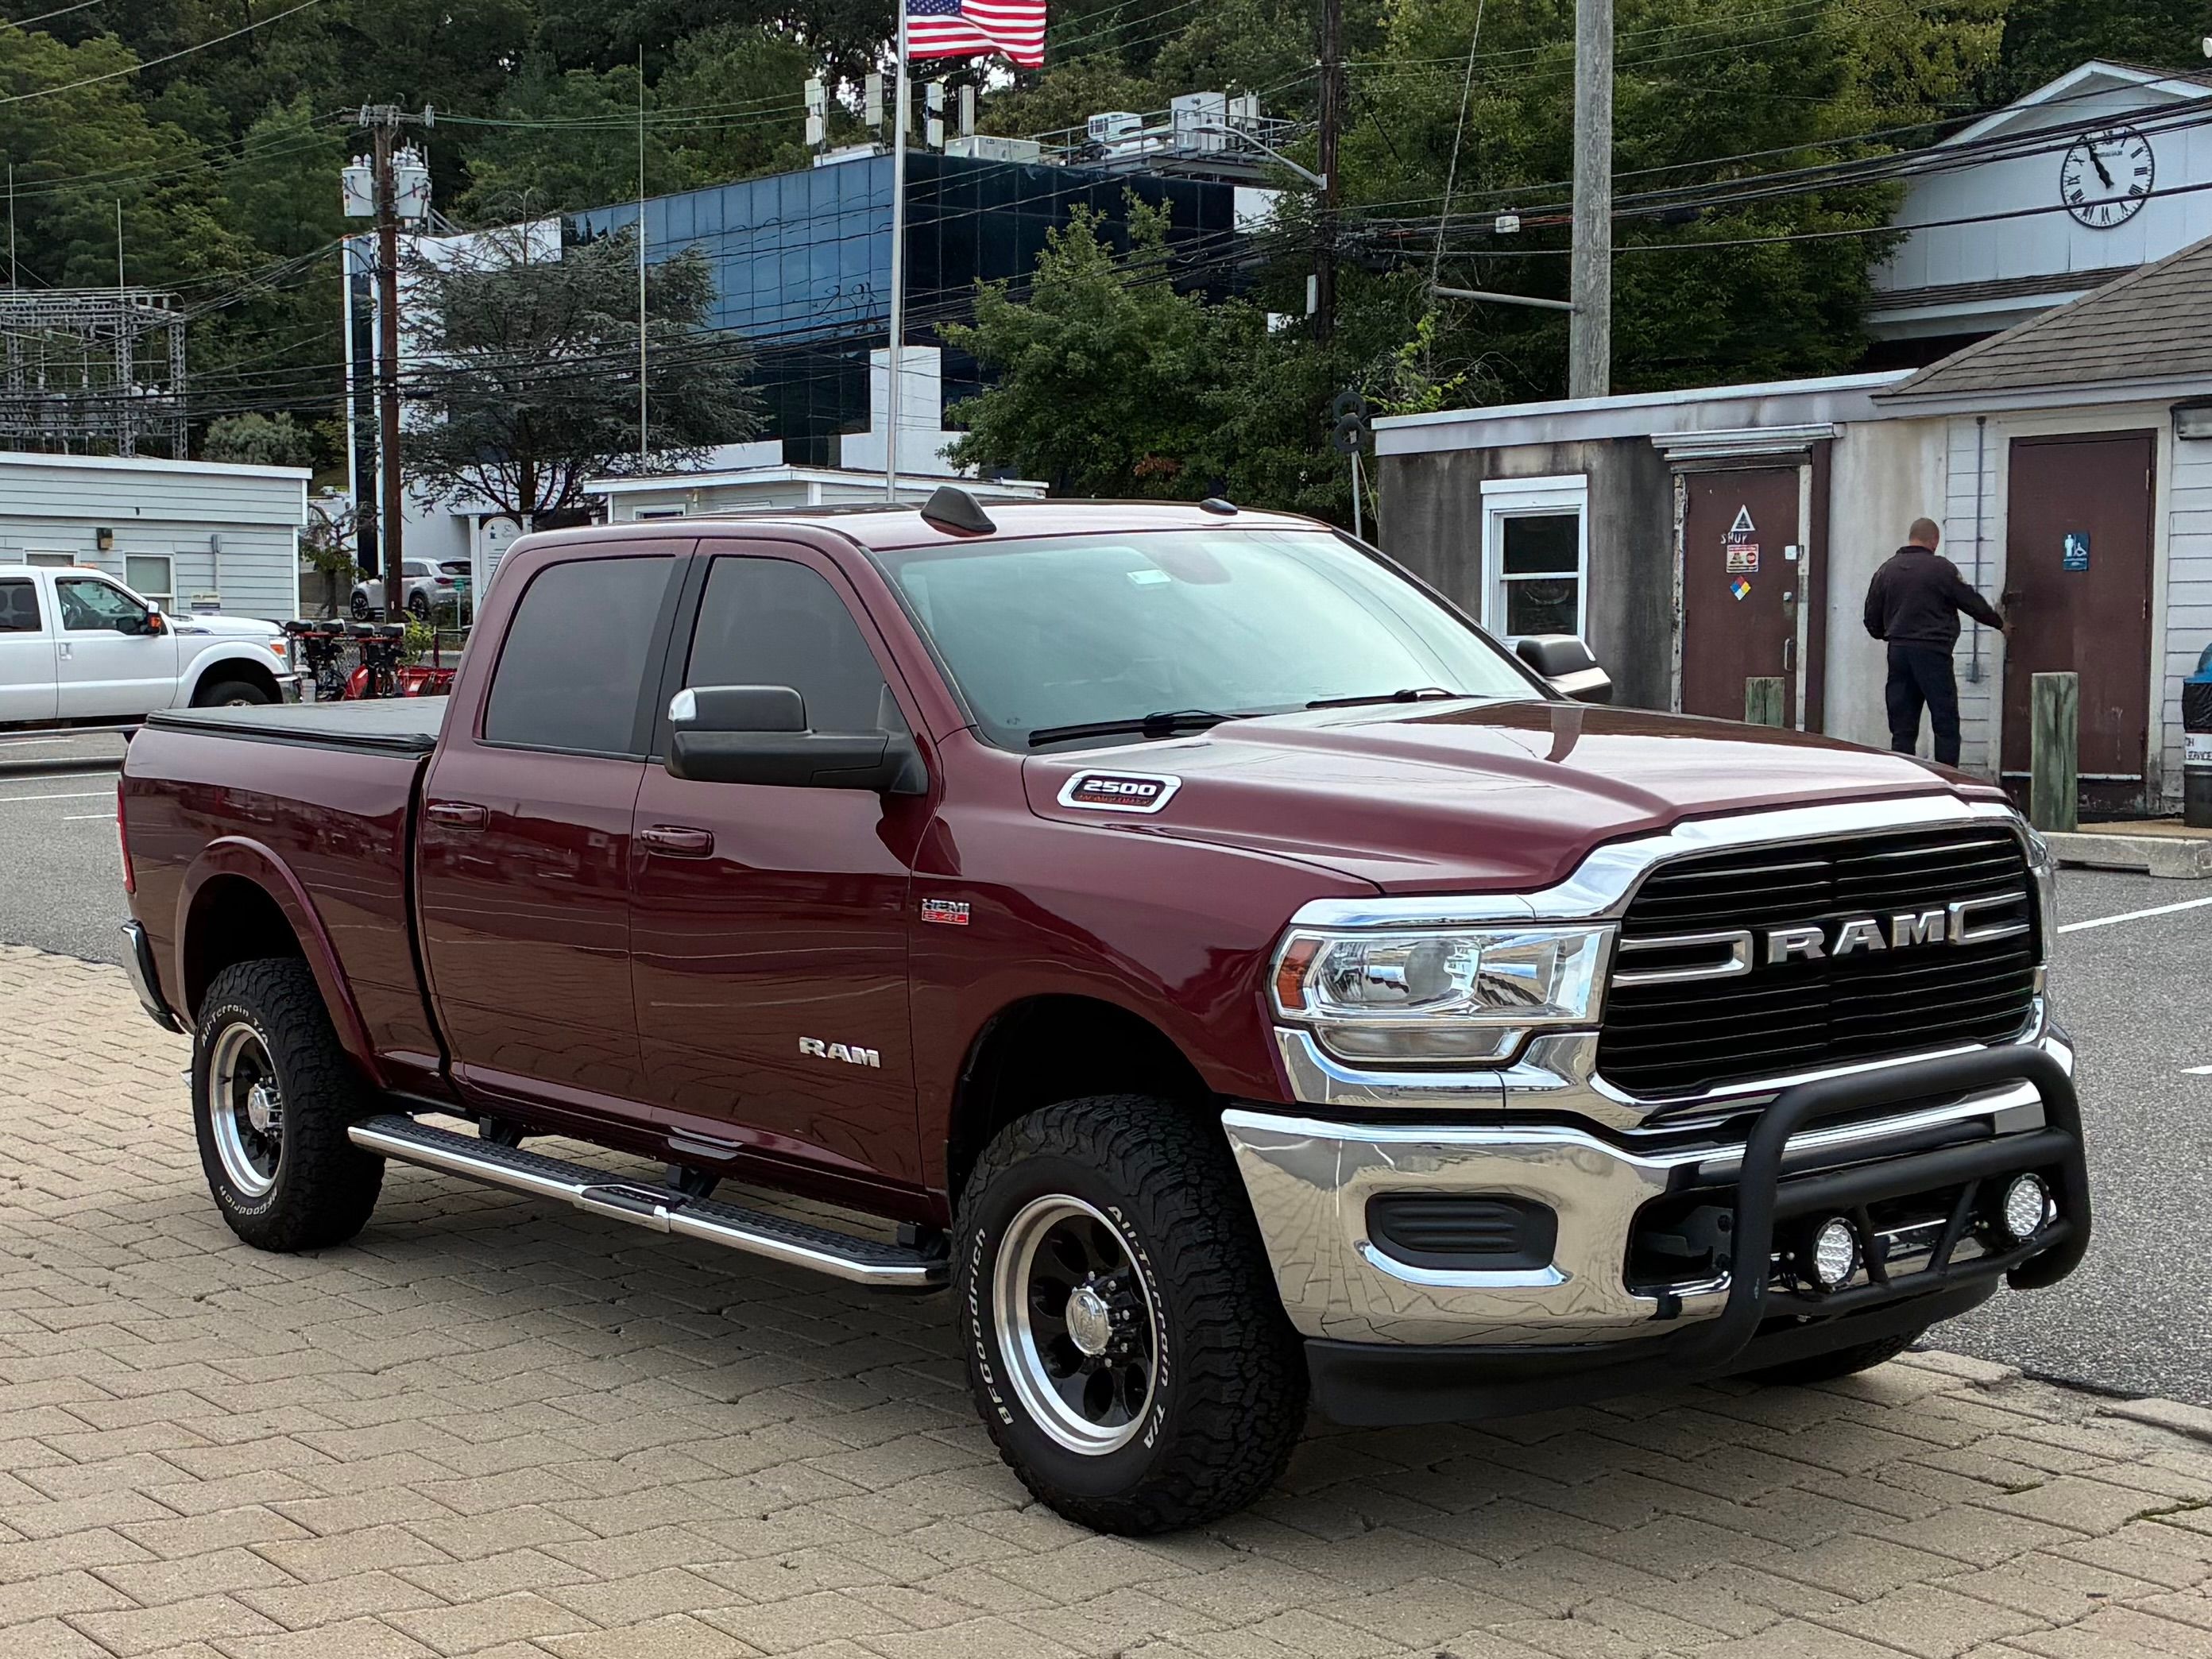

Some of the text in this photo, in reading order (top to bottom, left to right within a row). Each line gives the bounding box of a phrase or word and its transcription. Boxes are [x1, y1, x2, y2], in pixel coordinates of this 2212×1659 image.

[1083, 779, 1157, 796] 2500
[1767, 910, 1945, 964] RAM
[799, 1036, 880, 1068] RAM
[1108, 1206, 1170, 1386] All-Terrain
[969, 1228, 1015, 1425] BFGoodrich
